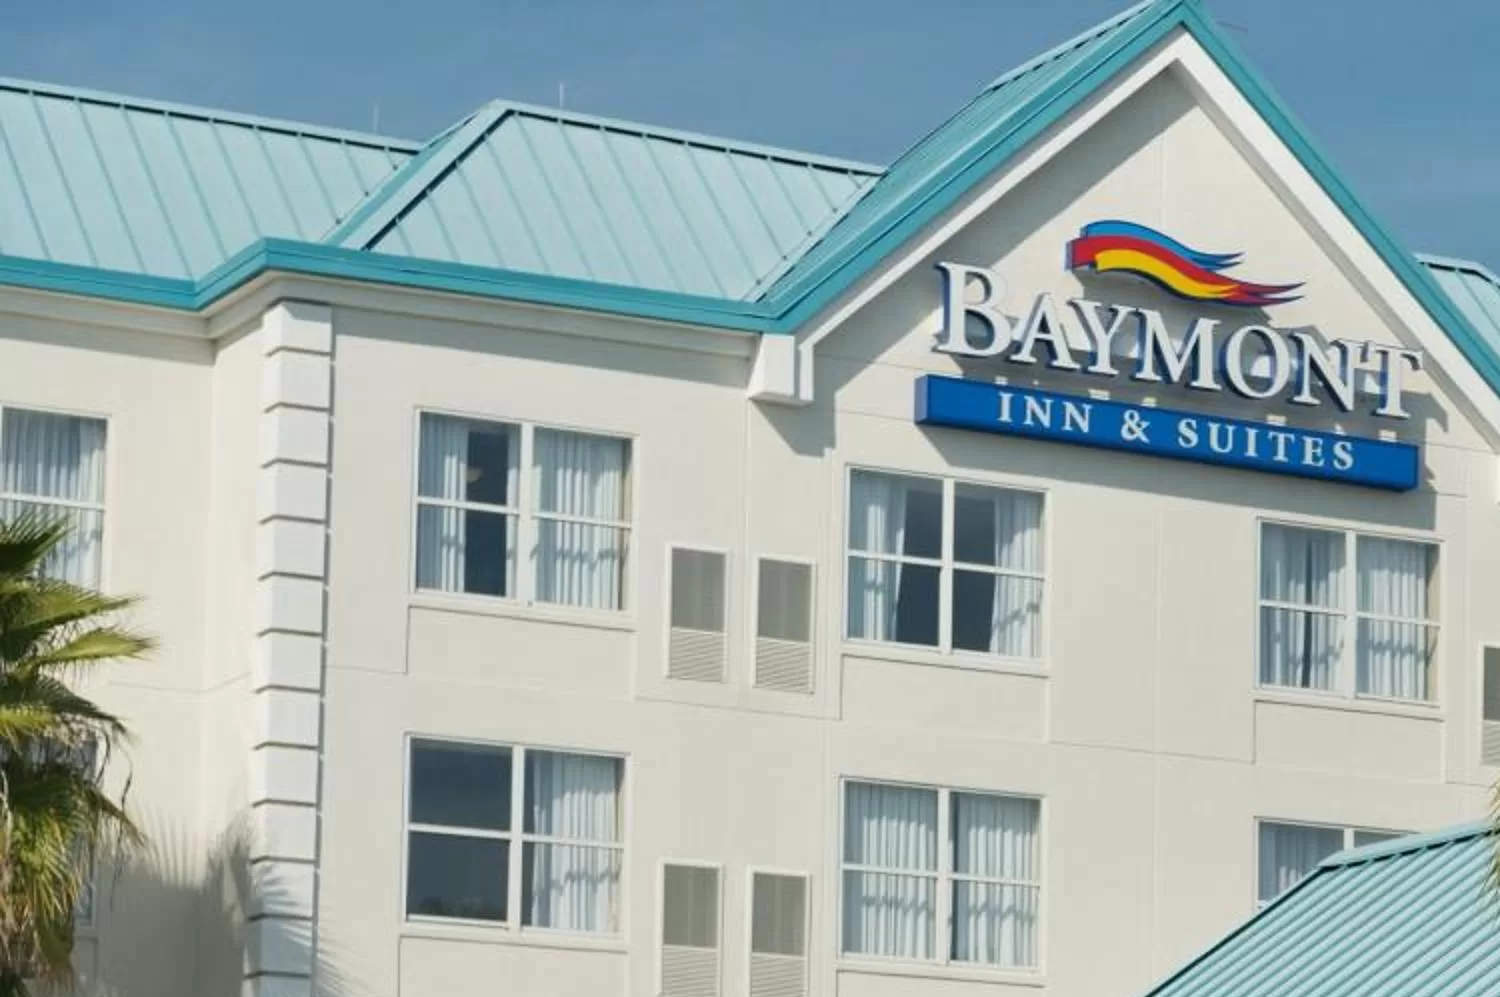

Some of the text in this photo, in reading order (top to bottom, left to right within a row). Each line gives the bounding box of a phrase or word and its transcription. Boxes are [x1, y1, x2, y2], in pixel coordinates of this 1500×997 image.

[935, 261, 1424, 419] BAYMONT
[996, 391, 1356, 471] INN & SUITES
